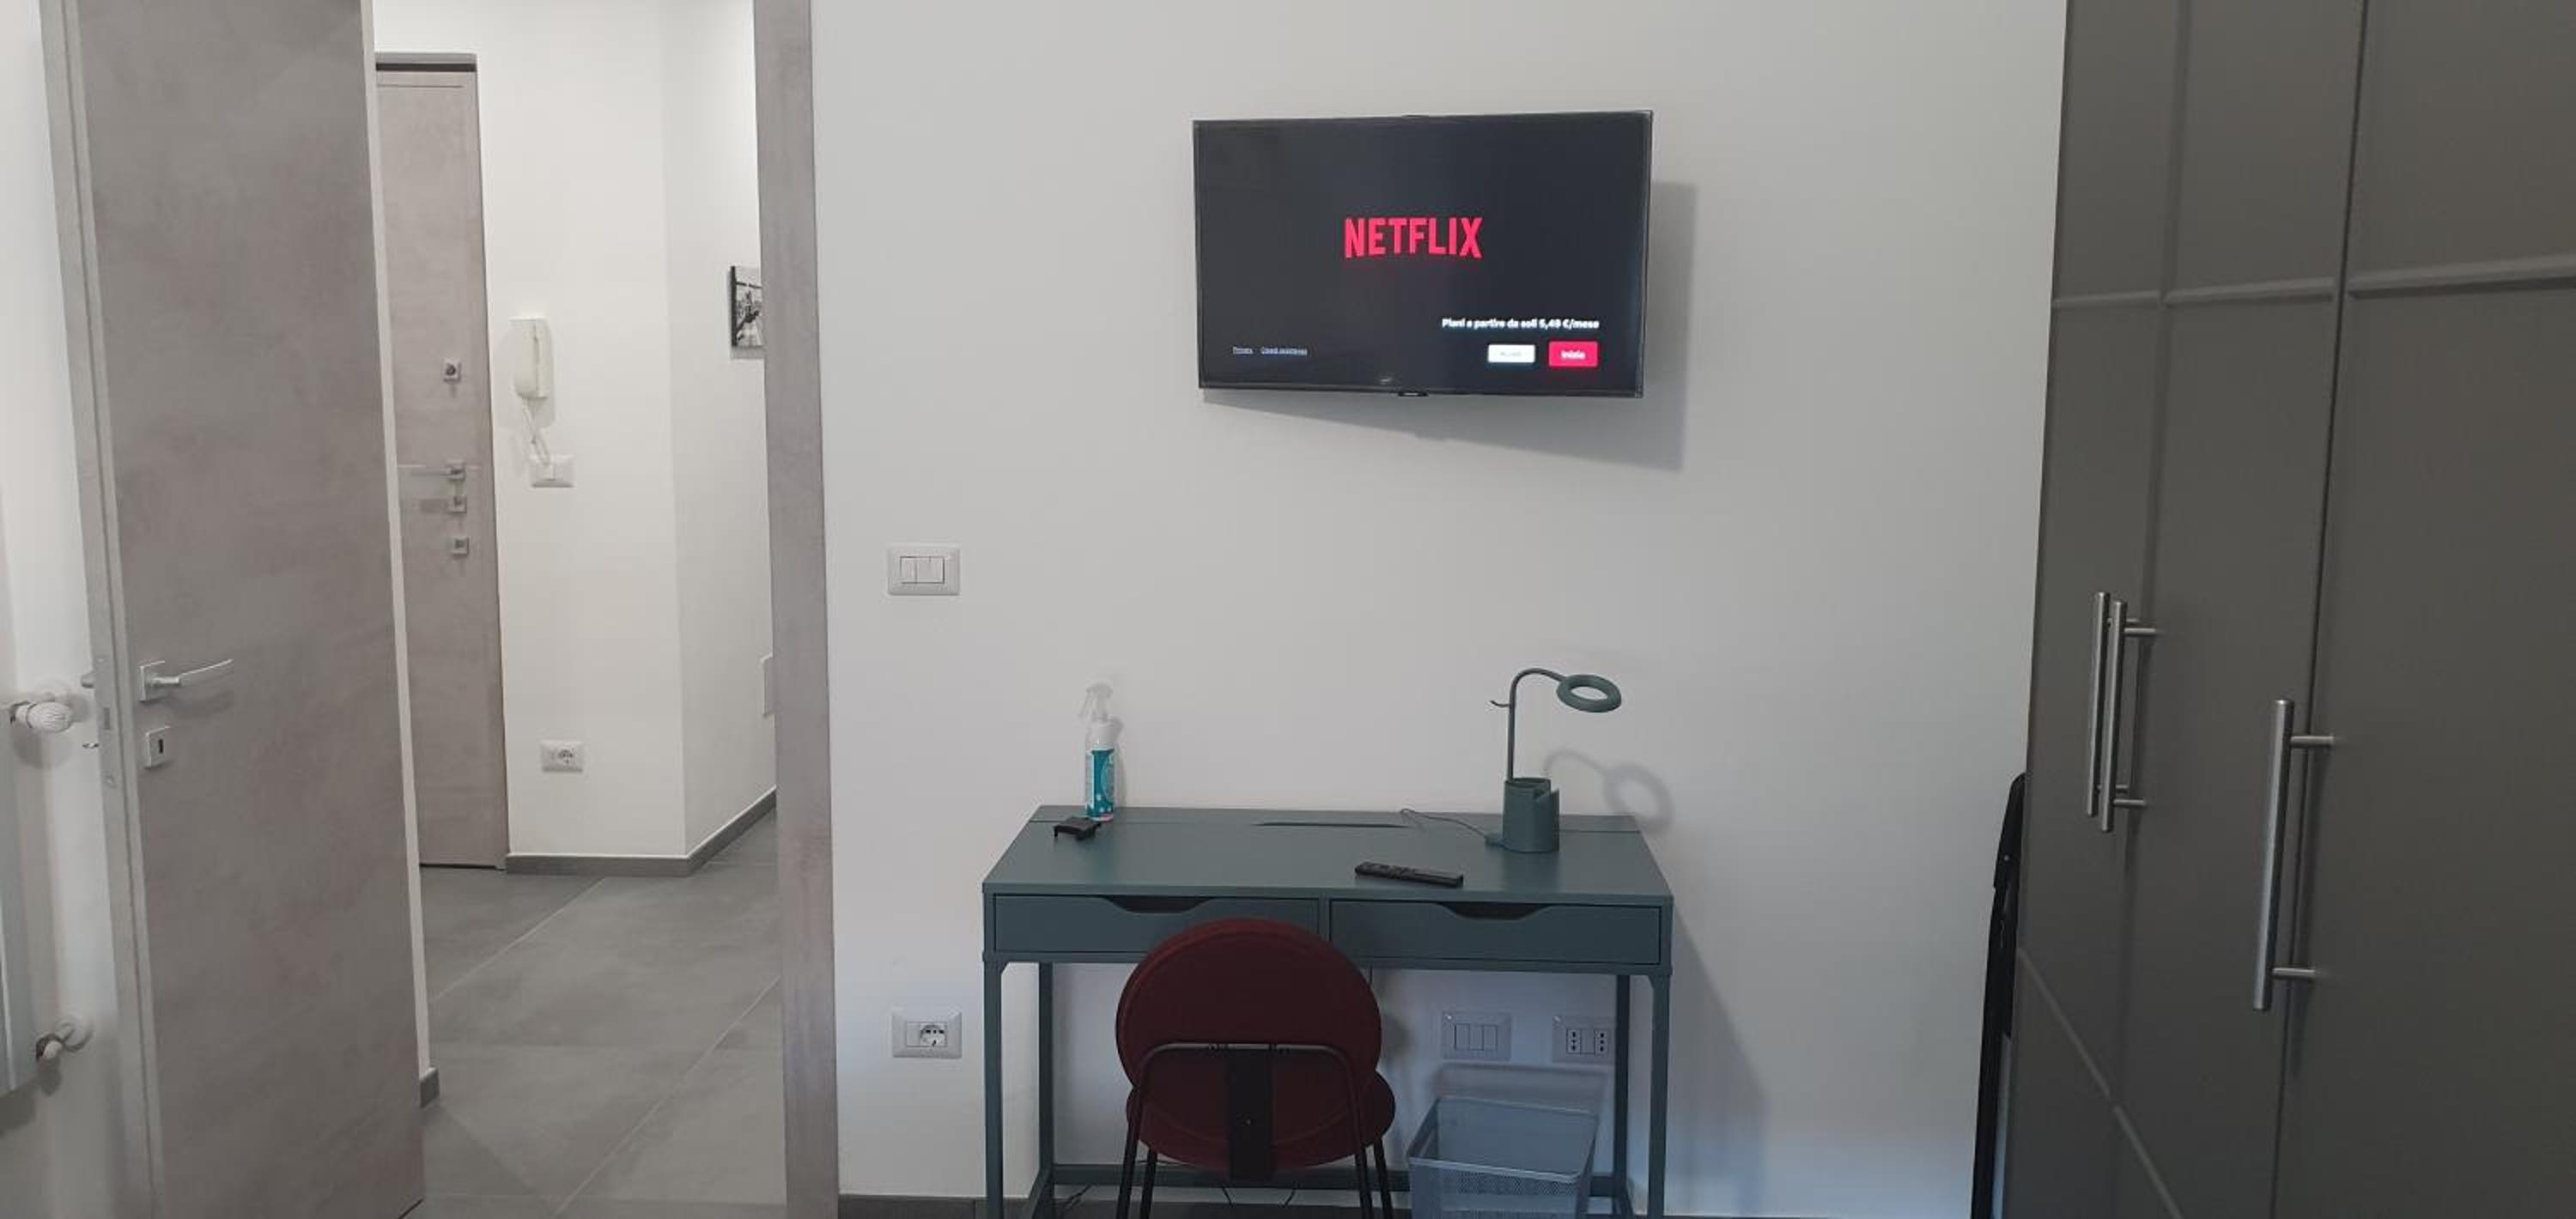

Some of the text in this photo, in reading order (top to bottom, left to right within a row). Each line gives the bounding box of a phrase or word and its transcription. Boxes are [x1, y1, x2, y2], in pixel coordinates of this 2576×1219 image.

[1344, 217, 1484, 258] NETFLIX
[1442, 318, 1465, 328] Piani
[1473, 318, 1504, 330] partire
[1507, 318, 1519, 329] da
[1521, 318, 1538, 328] soli
[1563, 318, 1600, 330] €/mese
